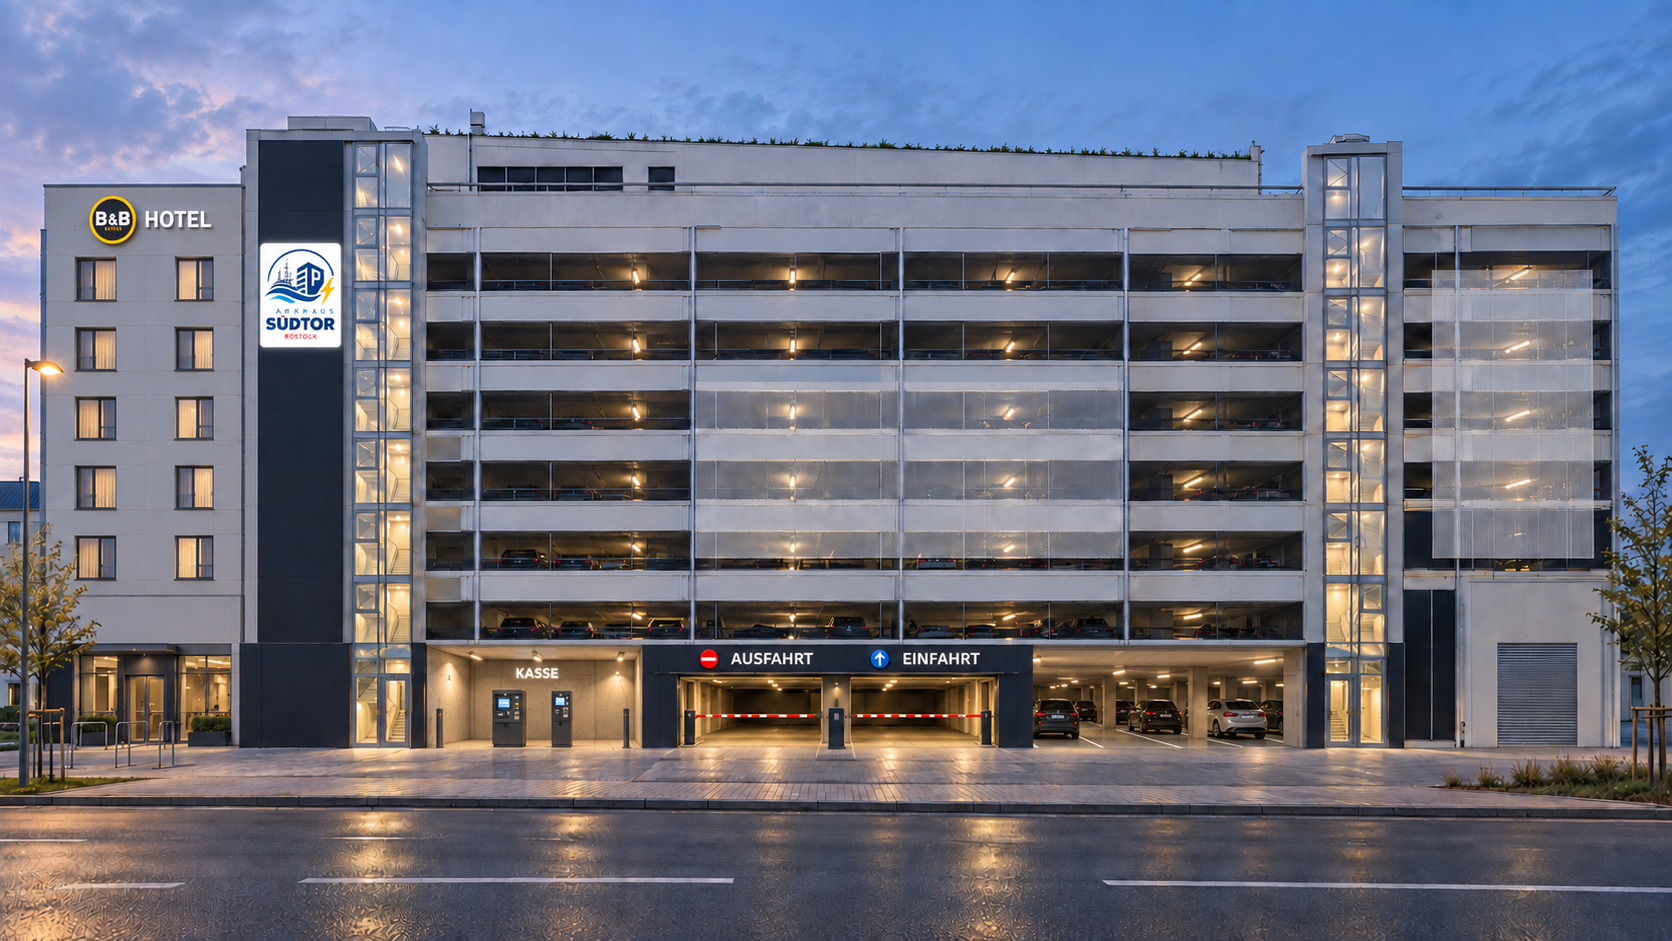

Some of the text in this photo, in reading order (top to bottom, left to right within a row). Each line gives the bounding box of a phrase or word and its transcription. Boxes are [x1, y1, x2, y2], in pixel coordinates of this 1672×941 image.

[95, 210, 212, 228] B&B HOTEL
[311, 268, 321, 287] P
[265, 315, 335, 331] SÜDTOR
[730, 652, 814, 665] AUSFAHRT
[903, 652, 981, 665] EINFAHRT
[515, 667, 559, 679] KASSE
